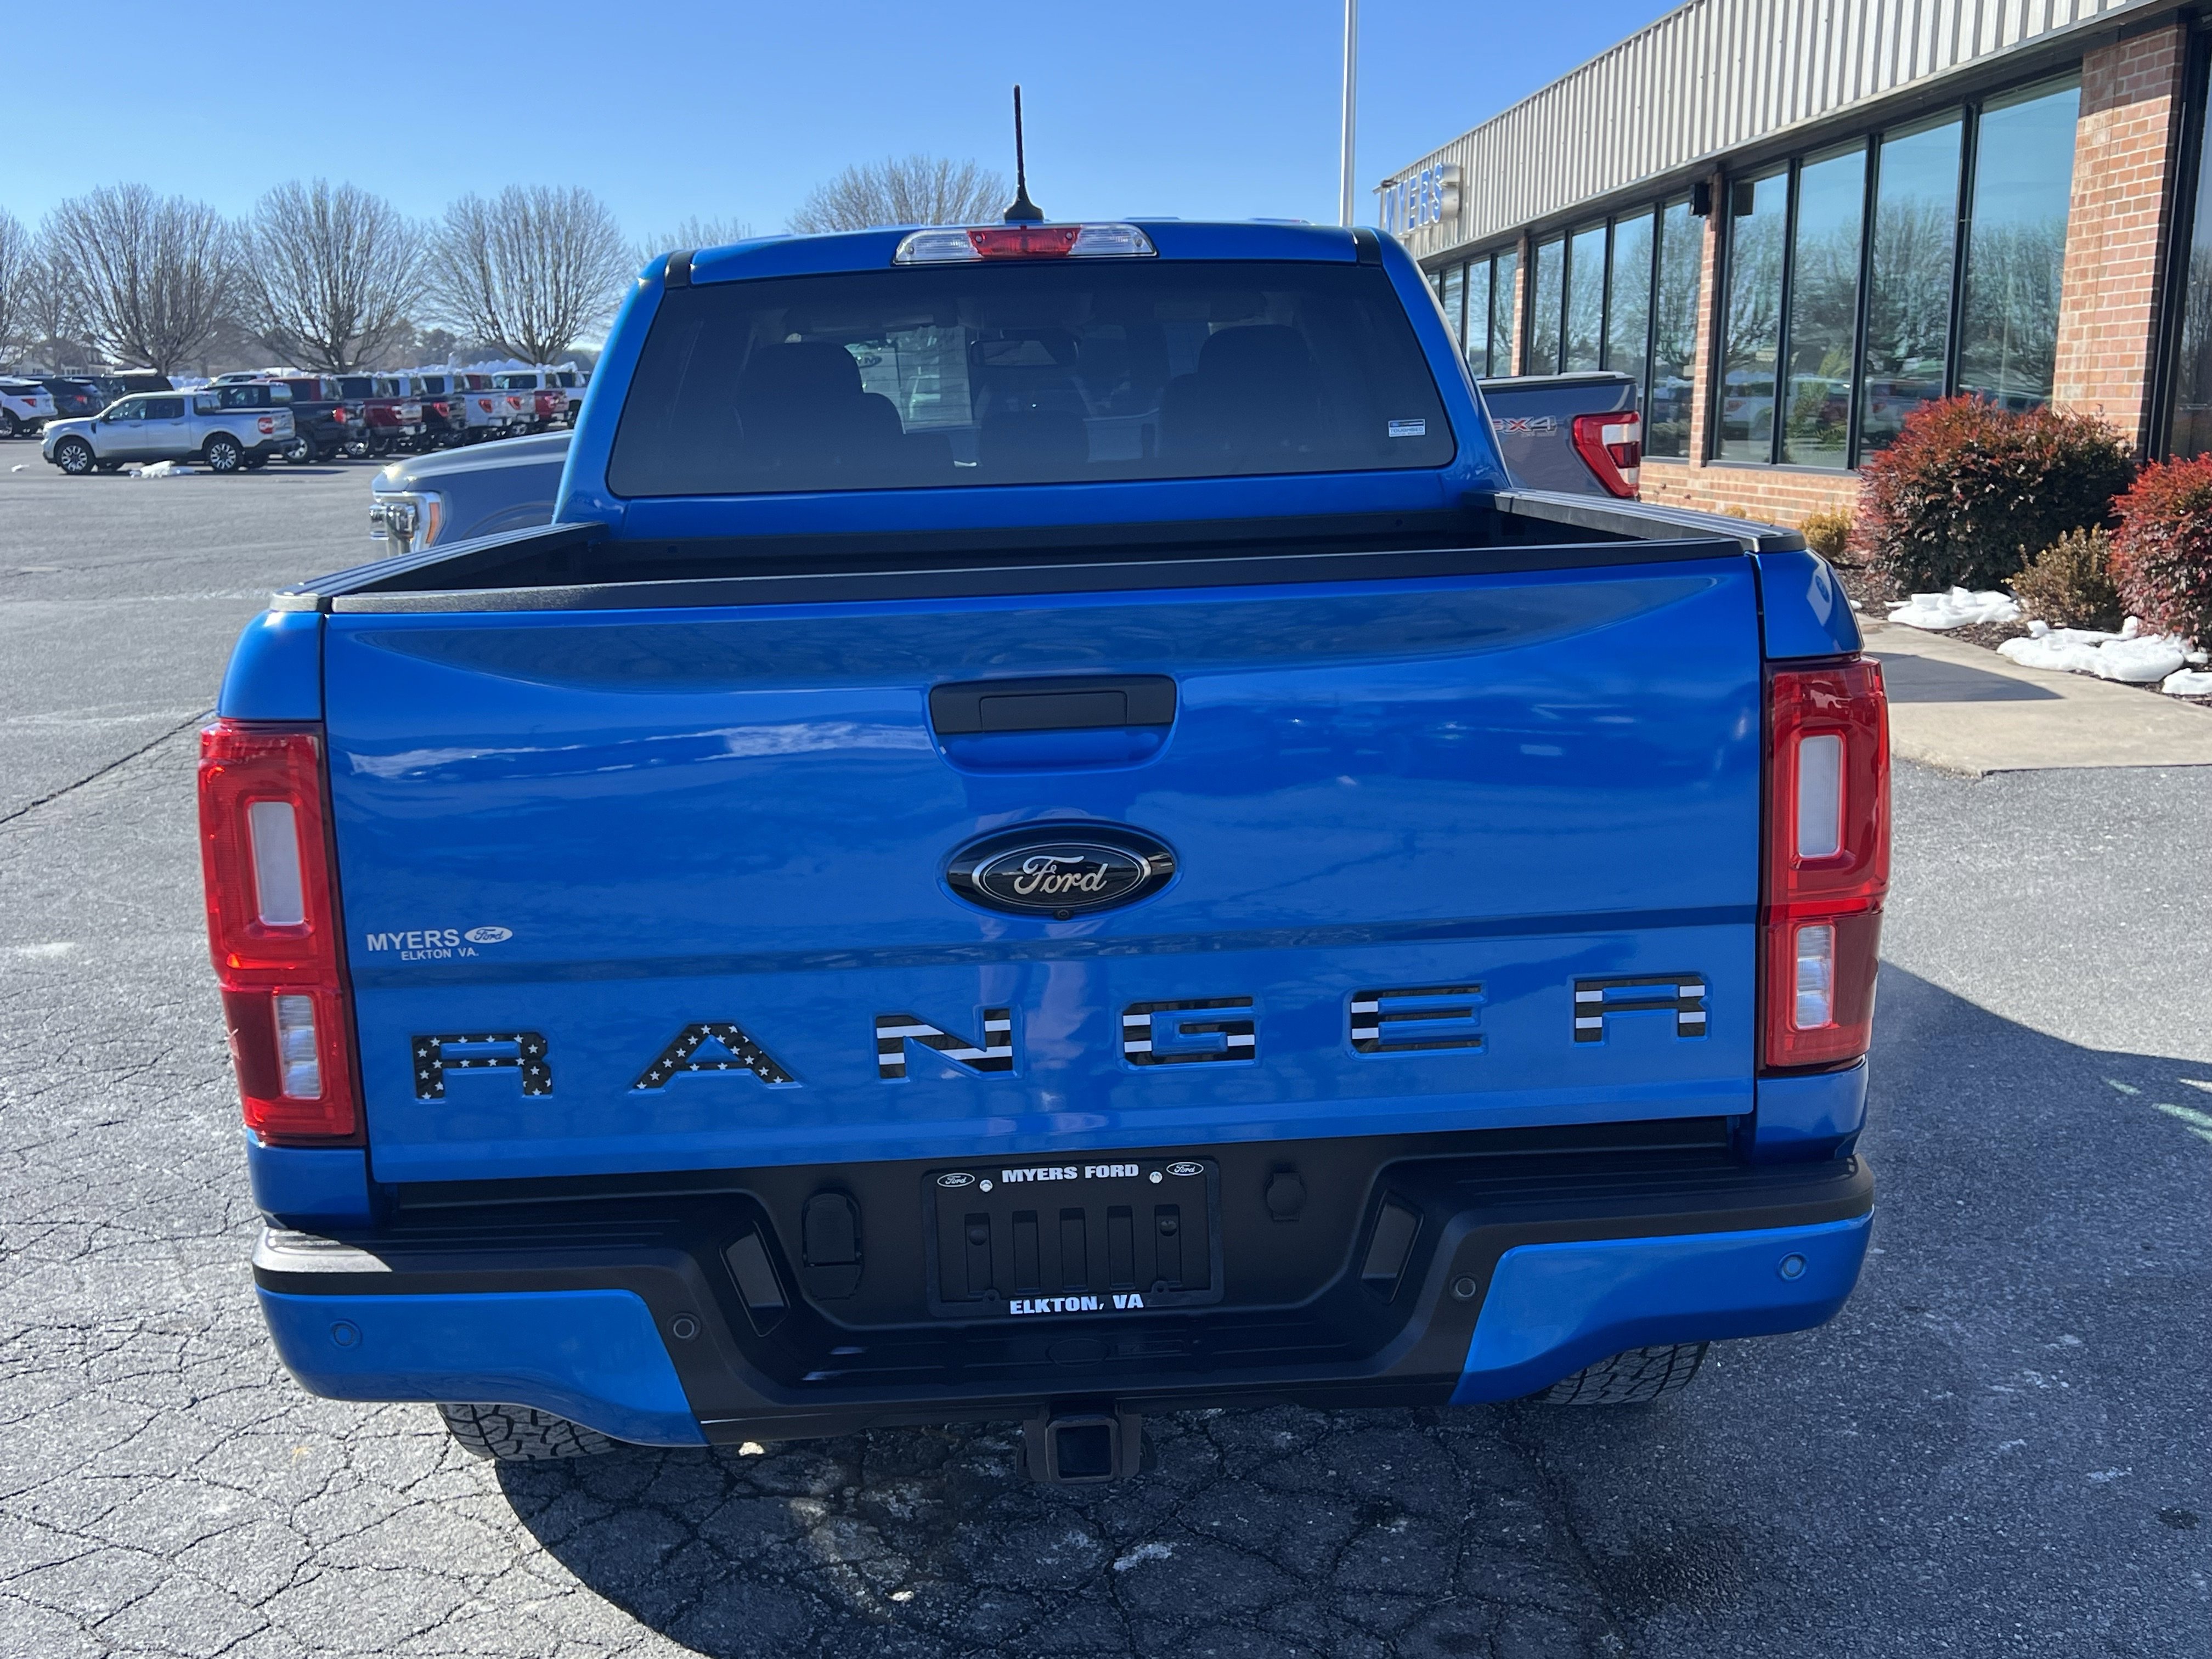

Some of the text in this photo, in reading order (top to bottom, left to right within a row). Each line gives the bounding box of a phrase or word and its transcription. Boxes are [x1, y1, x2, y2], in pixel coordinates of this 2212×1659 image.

[1014, 855, 1109, 895] Ford
[366, 929, 504, 951] MYERS Ford
[401, 947, 479, 961] ELKTON VA.
[410, 973, 1707, 1103] RANGER
[944, 1164, 1196, 1184] Ford MYERS FORD Ford
[1009, 1294, 1144, 1314] ELKTON, VA
